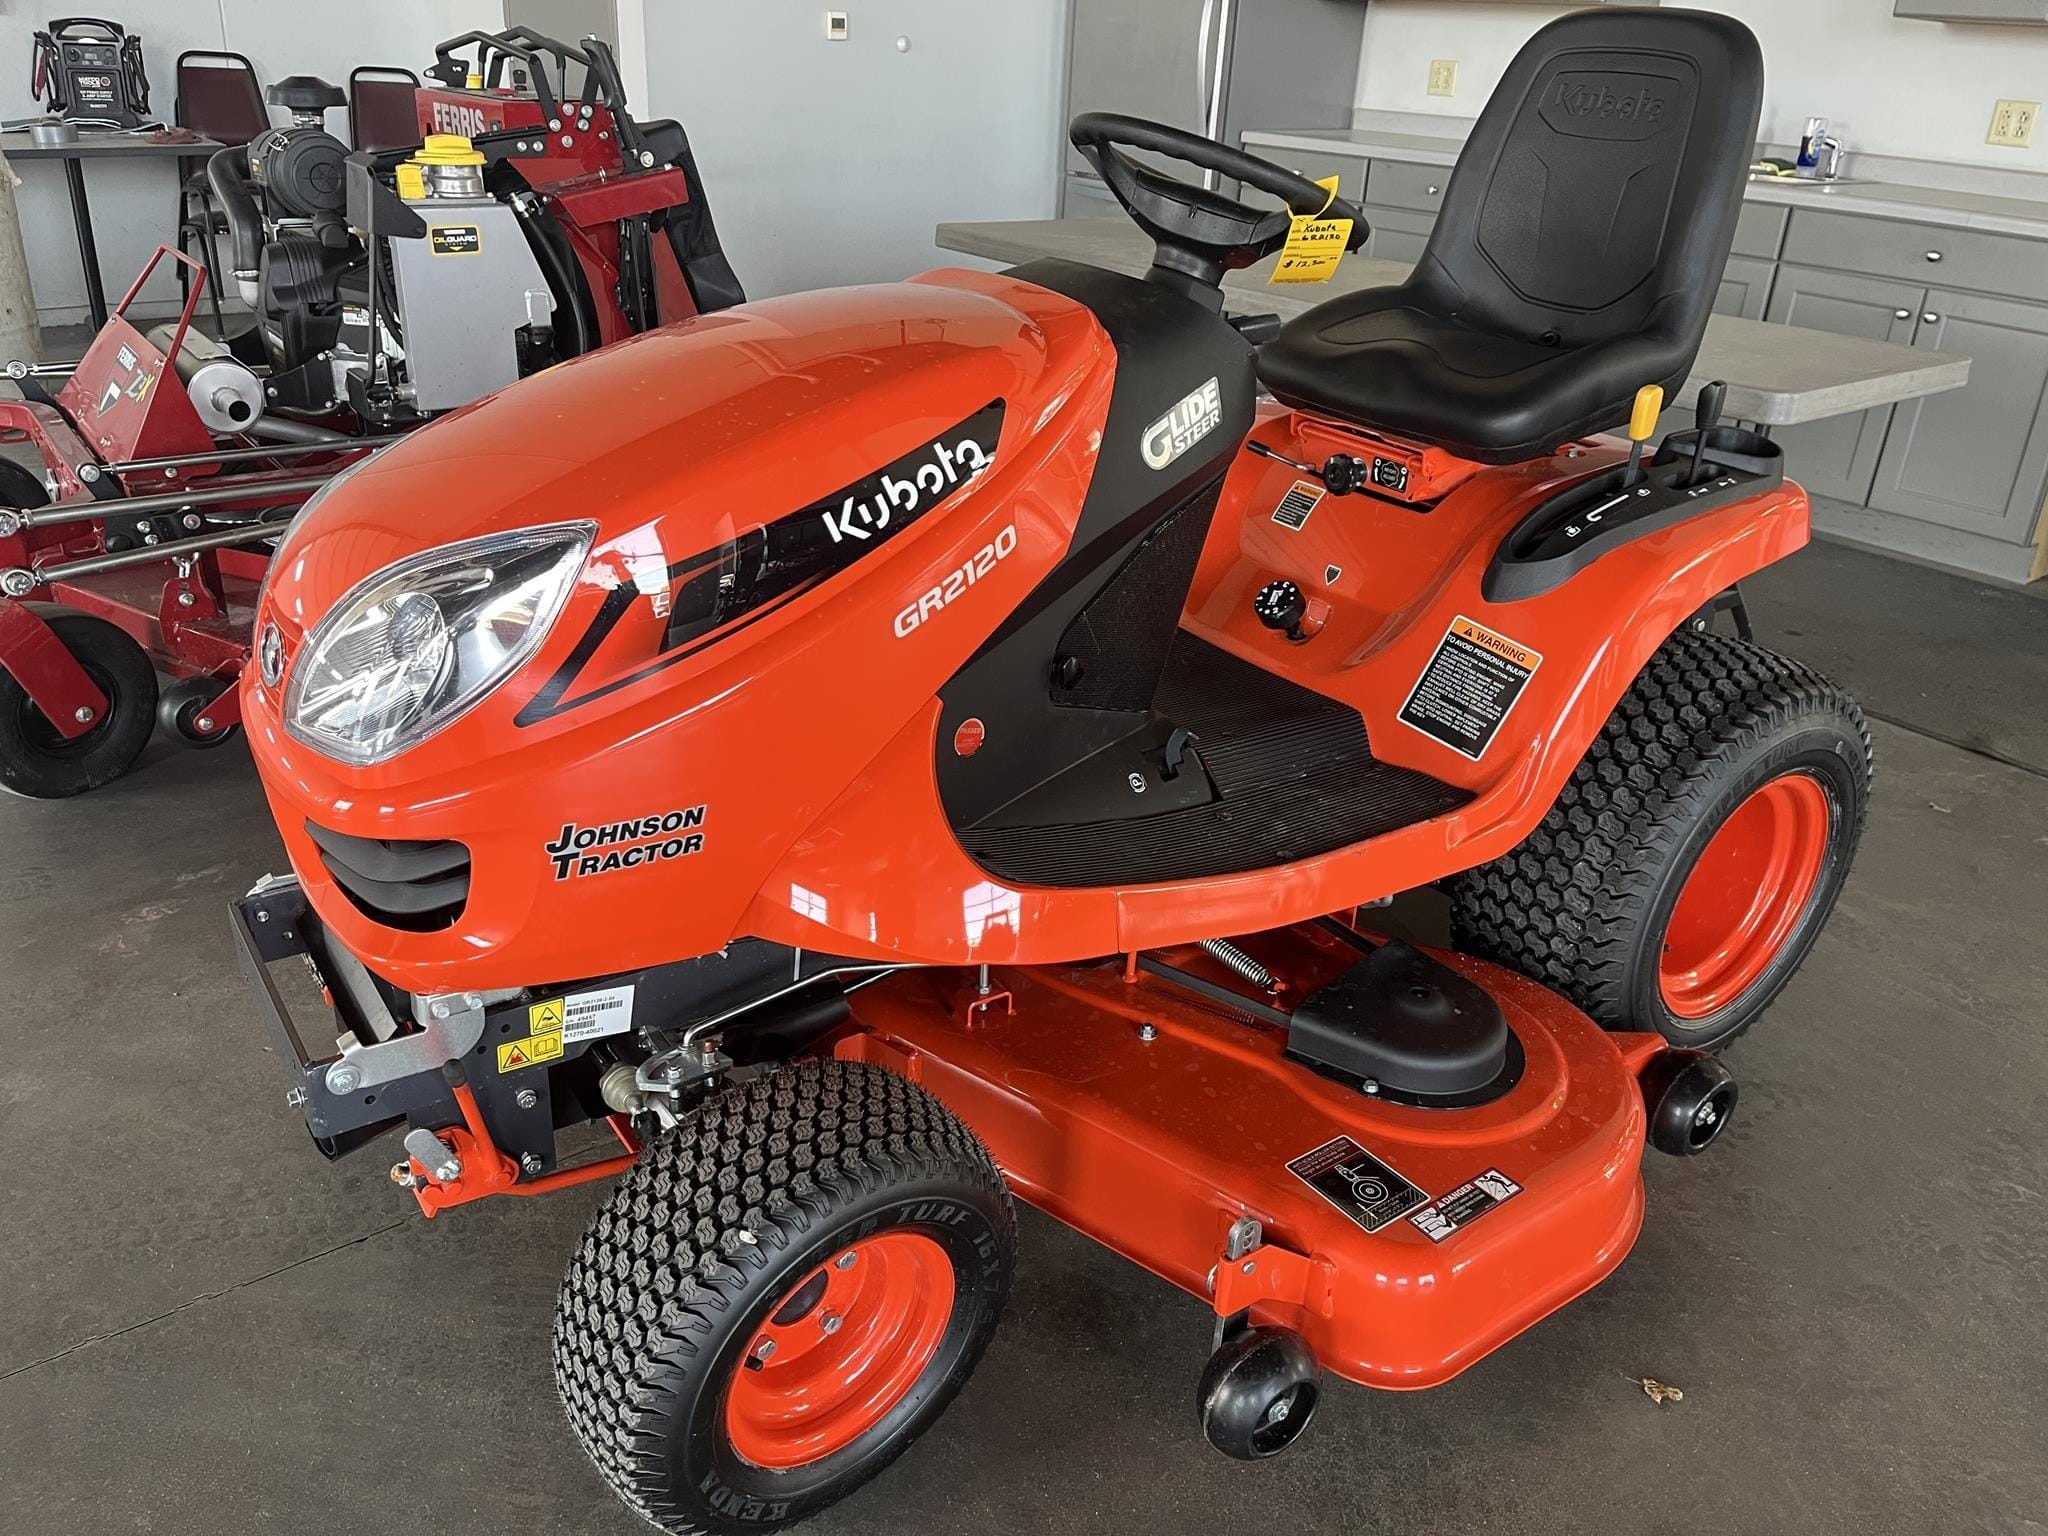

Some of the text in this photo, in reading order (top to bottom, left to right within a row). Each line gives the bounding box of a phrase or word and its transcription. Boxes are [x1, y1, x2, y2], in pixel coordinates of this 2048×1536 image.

[433, 101, 486, 138] FERRIS
[1554, 82, 1665, 121] Kubota
[1142, 381, 1219, 468] GLIDE
[1174, 409, 1221, 454] STEER
[821, 438, 990, 544] Kubota
[893, 524, 1018, 638] GR2120
[1447, 634, 1530, 680] TO AVOID PERSONAL INJURY
[1476, 631, 1526, 662] WARNING
[546, 806, 705, 853] JOHNSON
[551, 834, 704, 881] TRACTOR
[898, 1203, 972, 1226] TURF
[1441, 1184, 1474, 1204] DANGER
[700, 1471, 789, 1522] KENDA
